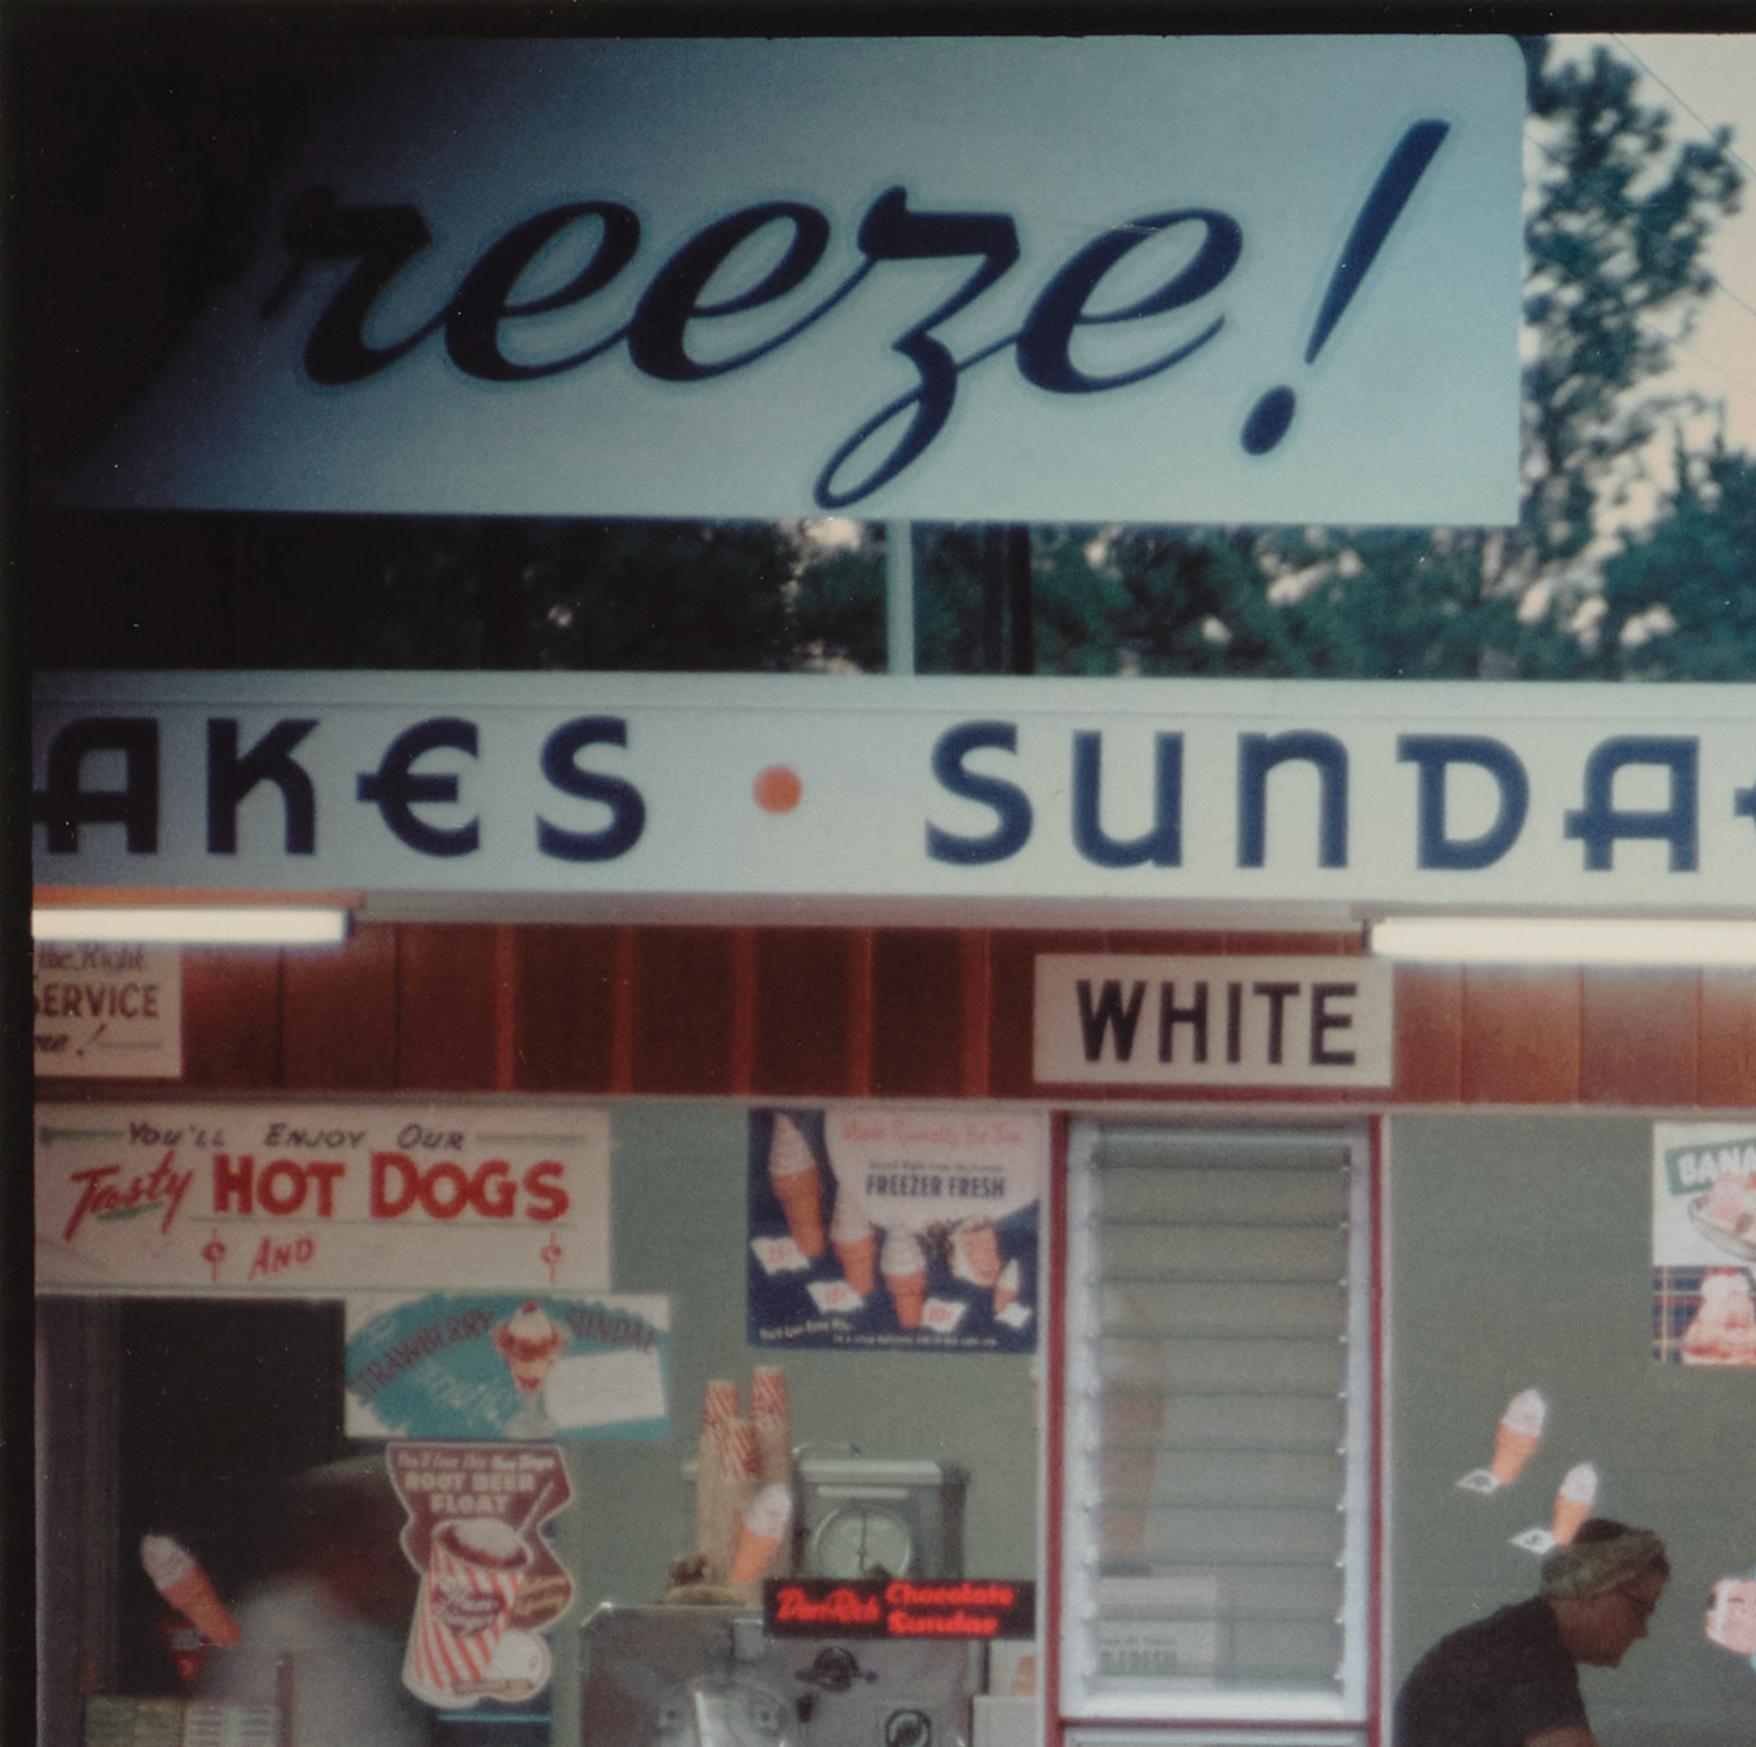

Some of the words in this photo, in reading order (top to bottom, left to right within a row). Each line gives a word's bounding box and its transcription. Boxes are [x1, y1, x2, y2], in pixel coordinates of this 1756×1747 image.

[35, 983, 159, 1019] ERVICE
[1075, 979, 1359, 1066] WHITE
[263, 1122, 367, 1149] ENJOY
[64, 1150, 195, 1241] Tasty
[212, 1154, 345, 1218] HOT
[369, 1151, 571, 1224] DOGS
[866, 1173, 942, 1197] FREEZER
[947, 1176, 1006, 1199] FRESH
[249, 1236, 317, 1282] AND
[405, 1471, 466, 1492] ROOT
[471, 1472, 536, 1492] BEER
[429, 1493, 509, 1514] FLOAT
